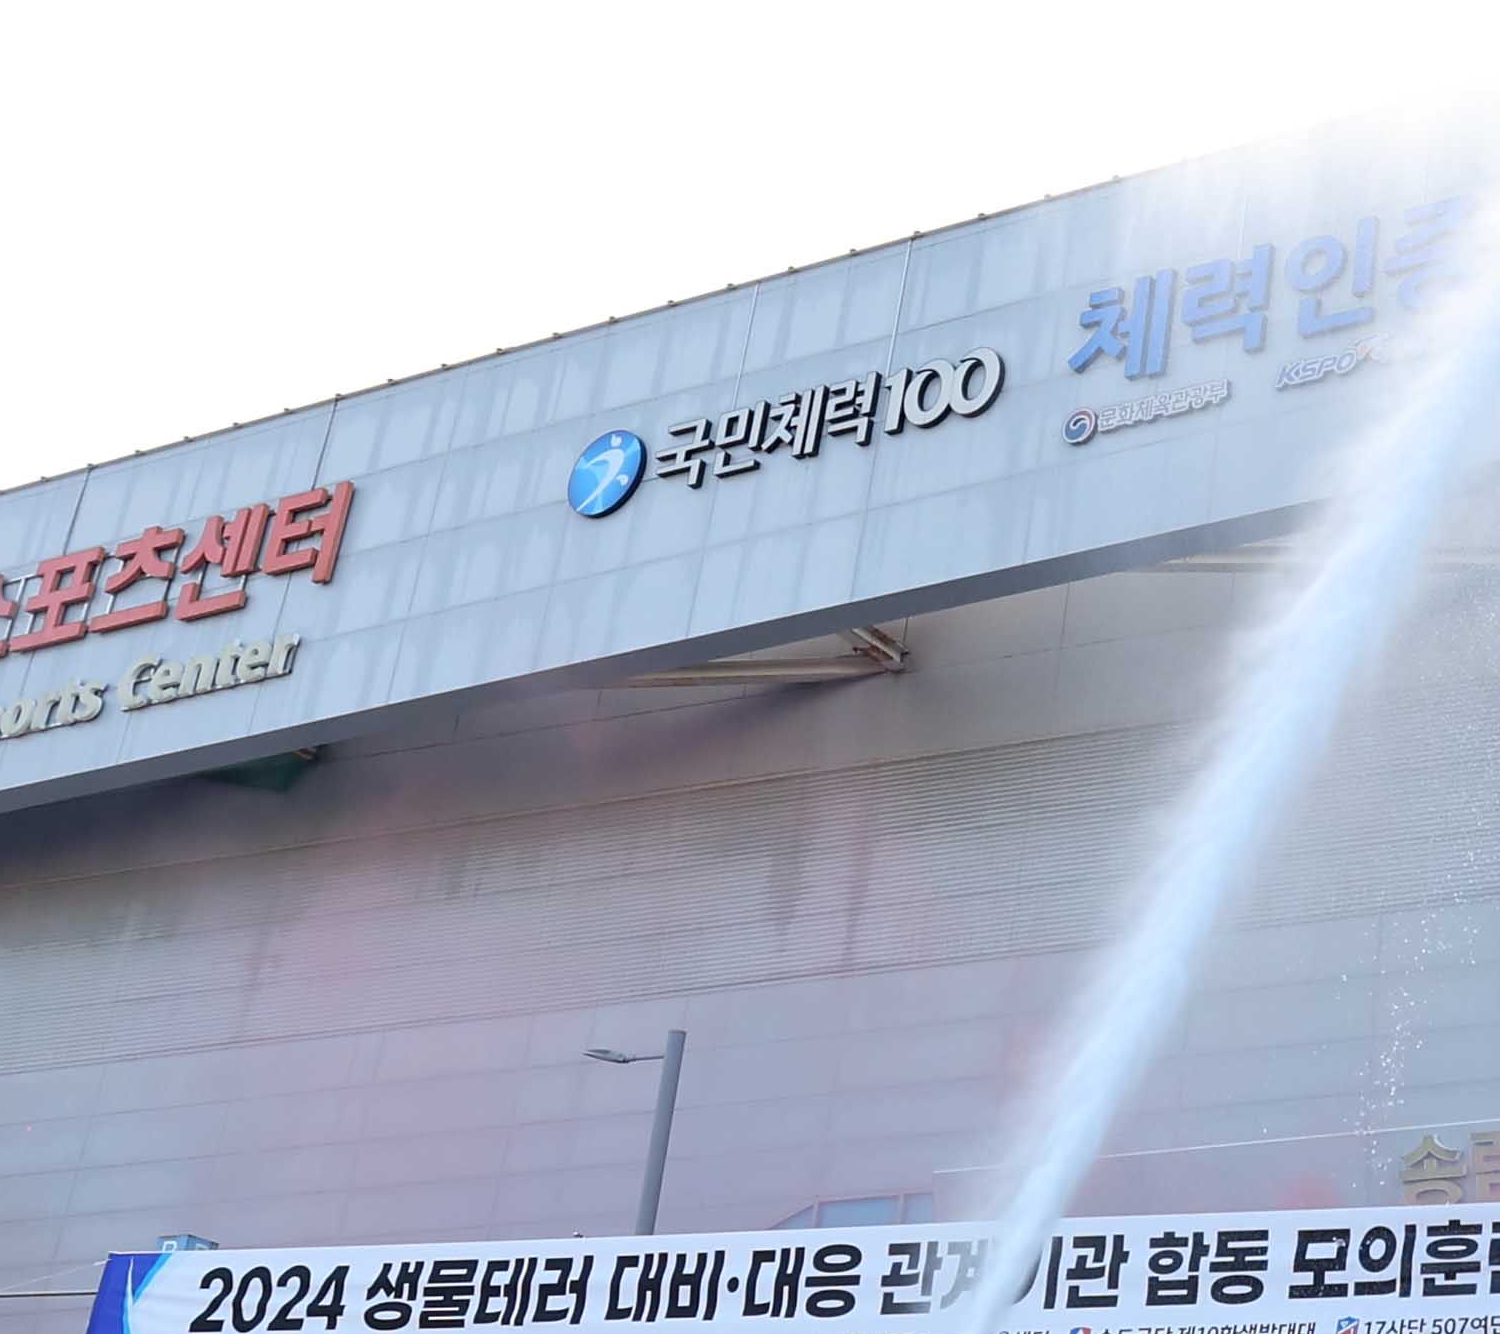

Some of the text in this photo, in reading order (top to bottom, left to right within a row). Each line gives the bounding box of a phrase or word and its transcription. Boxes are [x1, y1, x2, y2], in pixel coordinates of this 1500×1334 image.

[1098, 378, 1231, 432] 문화체육관광부
[1276, 348, 1357, 390] KSPO
[655, 346, 1006, 489] 국민체력100
[117, 633, 300, 712] Center
[188, 1264, 350, 1334] 2024
[363, 1255, 594, 1331] 생물테러
[604, 1243, 864, 1323] 대비·대응
[1145, 1229, 1269, 1307] 합동
